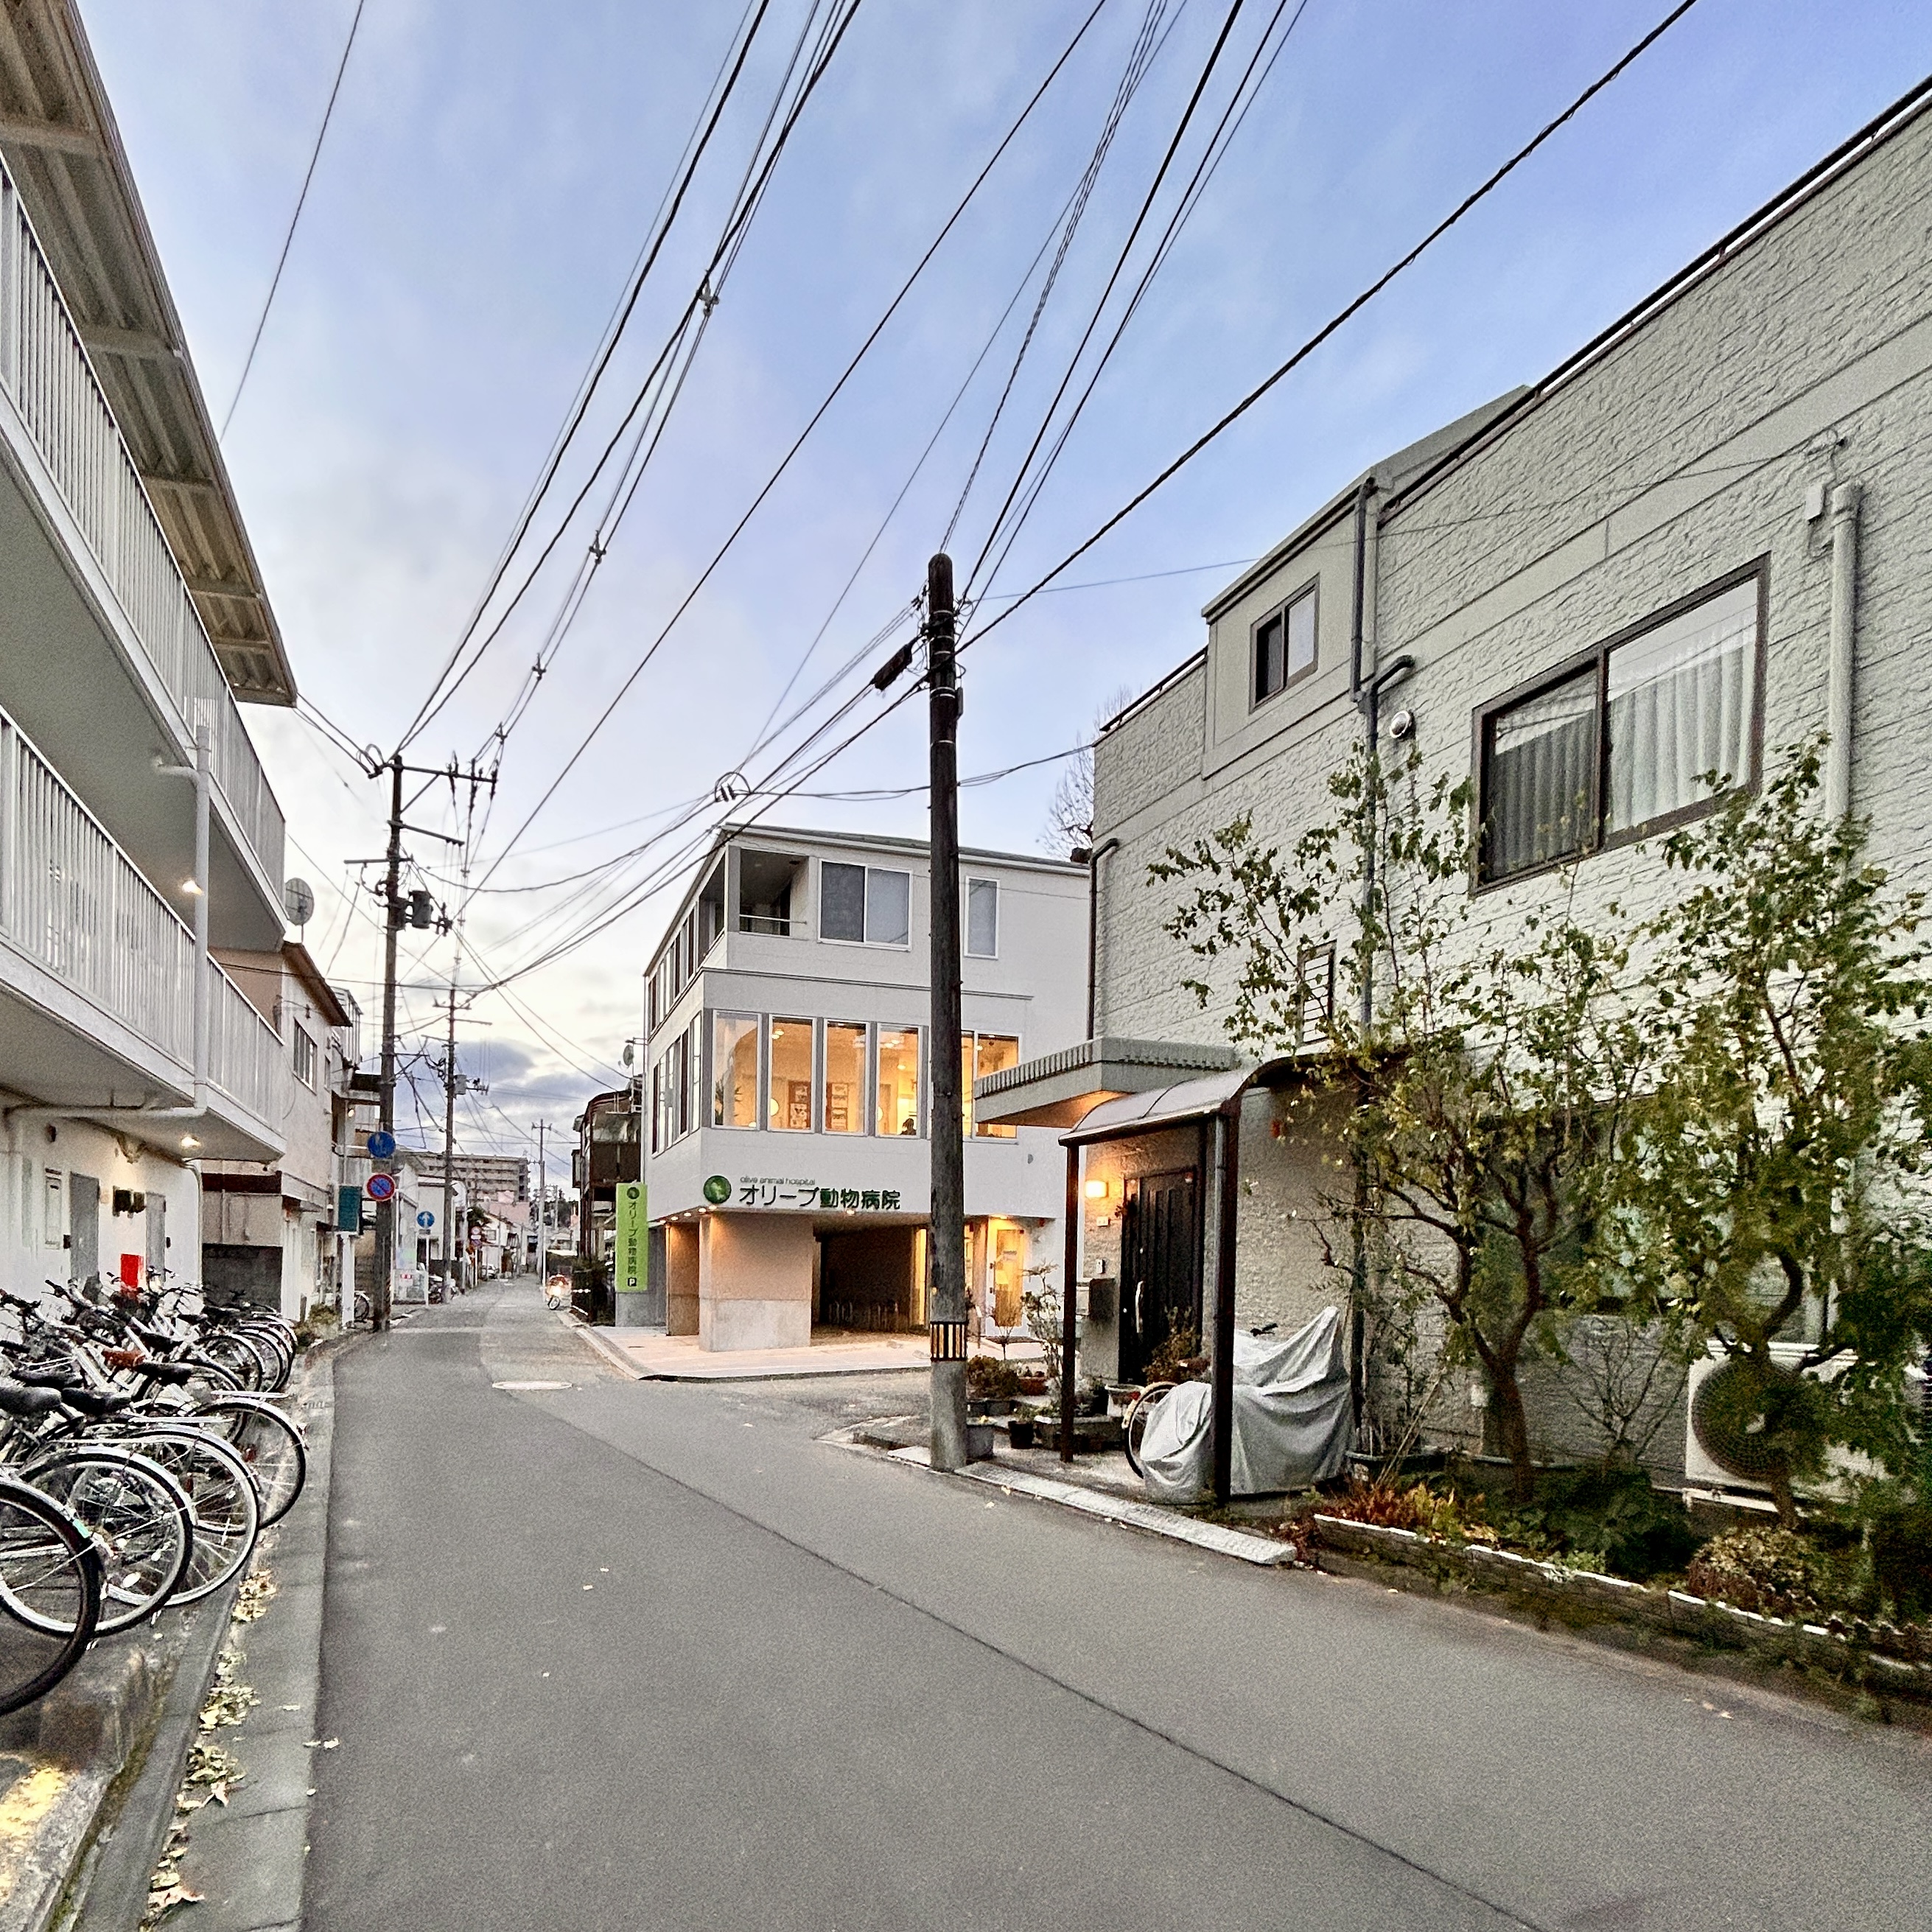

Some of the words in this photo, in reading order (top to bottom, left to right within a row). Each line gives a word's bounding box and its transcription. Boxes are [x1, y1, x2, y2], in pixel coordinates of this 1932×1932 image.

[760, 1177, 784, 1185] animal
[785, 1177, 815, 1186] hospital
[739, 1184, 900, 1210] オリーブ動物病院
[629, 1278, 636, 1287] P
